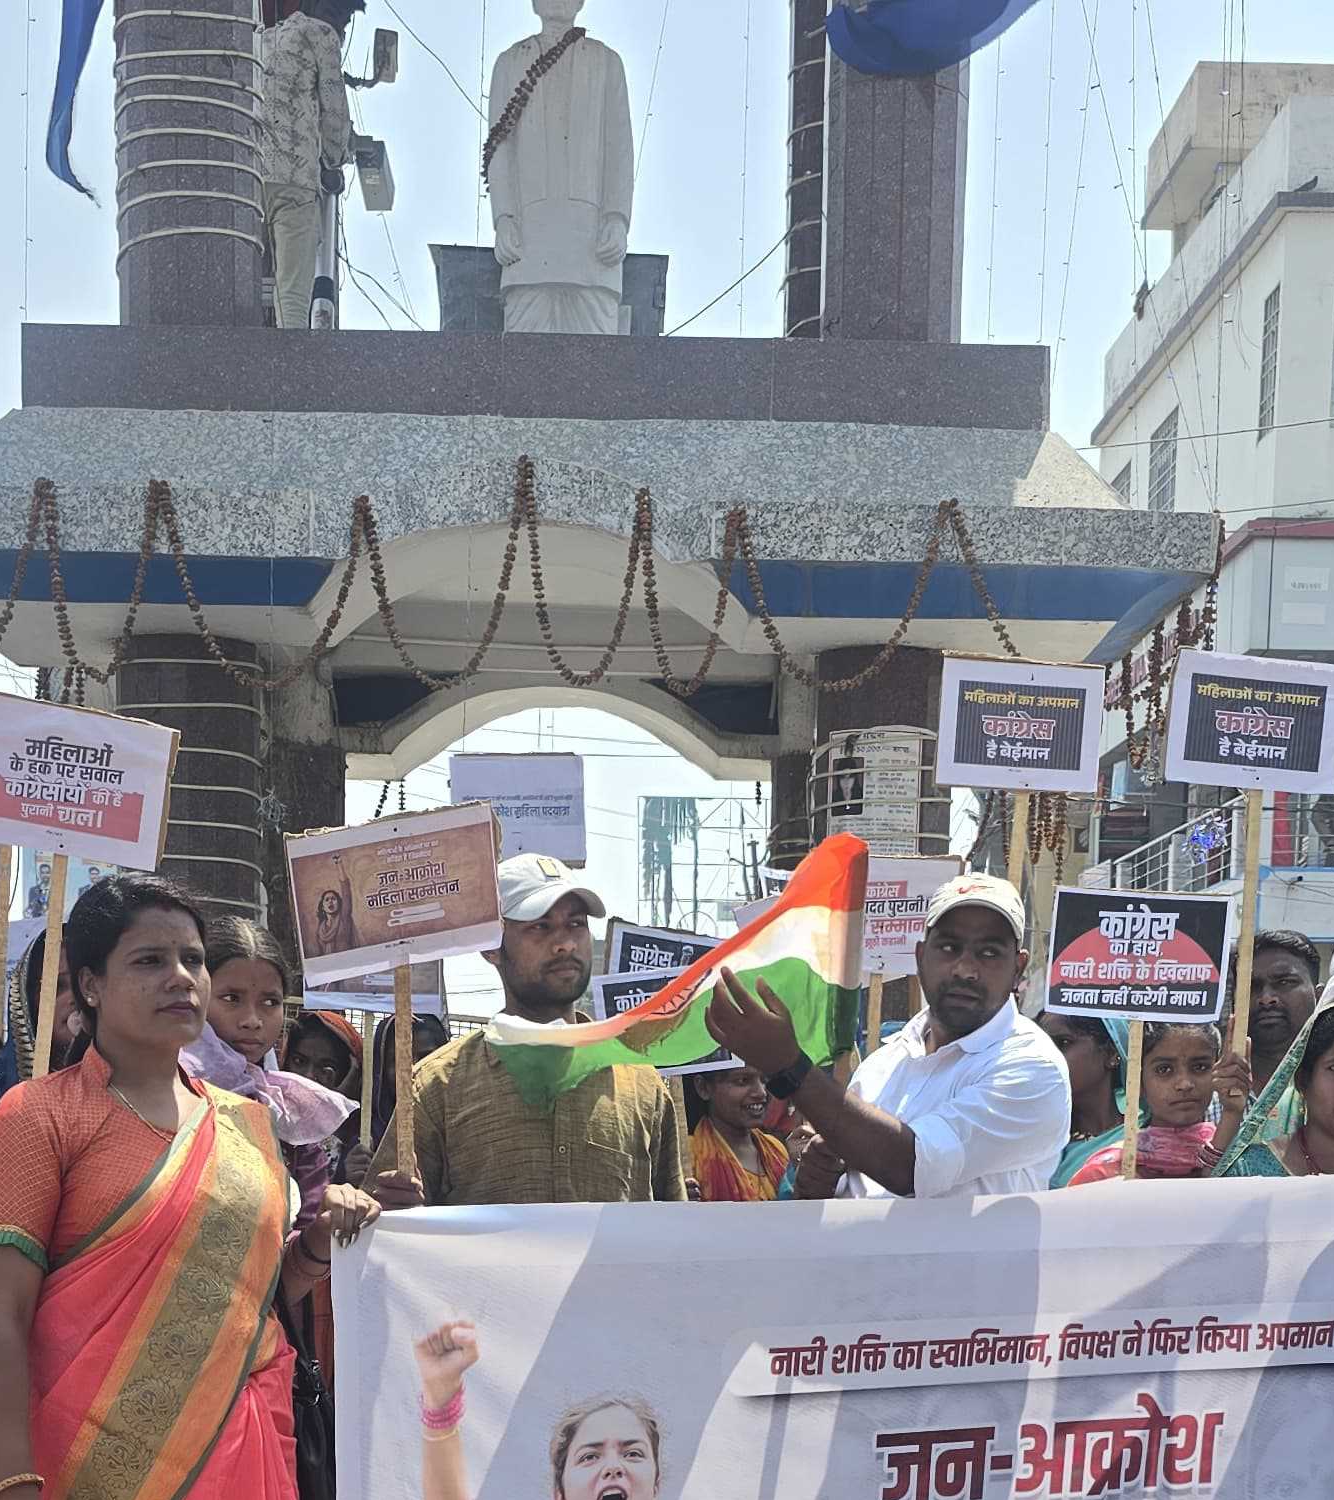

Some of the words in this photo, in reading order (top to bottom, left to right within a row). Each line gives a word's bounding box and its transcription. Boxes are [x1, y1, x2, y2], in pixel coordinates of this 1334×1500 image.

[964, 688, 1017, 705] महिलाओं
[1017, 695, 1036, 707] का
[1036, 696, 1080, 709] अपमान
[1197, 682, 1253, 701] महिलाओं
[1254, 690, 1274, 703] का
[1274, 692, 1321, 707] अपमान
[981, 710, 1056, 740] कांग्रेस
[1215, 706, 1295, 740] कांग्रेस
[24, 735, 115, 768] महिलाओं
[986, 738, 998, 759] है
[999, 740, 1051, 761] बेईमान
[1218, 735, 1232, 757] है
[1233, 738, 1288, 760] बेईमान
[8, 752, 26, 772] के
[26, 758, 52, 776] हक
[55, 763, 75, 779] पर
[78, 765, 126, 786] सवाल
[20, 801, 54, 819] पुरानी
[91, 788, 110, 806] की
[110, 789, 125, 808] है
[377, 860, 446, 887] जन-आक्रोश
[366, 888, 406, 909] महिला
[406, 878, 461, 902] सम्मेलन
[871, 919, 927, 935] सम्मान
[1098, 903, 1180, 941] कांग्रेस
[630, 943, 675, 967] कांग्रेस
[1109, 939, 1131, 956] का
[1060, 957, 1096, 979] नारी
[1098, 958, 1134, 980] शक्ति
[1135, 958, 1153, 981] के
[1154, 959, 1214, 982] खिलाफ
[1060, 988, 1101, 1005] जनता
[1101, 985, 1133, 1006] नहीं
[1130, 986, 1169, 1006] करेगी
[769, 1335, 829, 1377] नारी
[831, 1333, 891, 1375] शक्ति
[891, 1340, 927, 1371] का
[928, 1327, 1051, 1369] स्वाभिमान,
[1058, 1323, 1120, 1361] विपक्ष
[1121, 1319, 1146, 1357] ने
[1147, 1318, 1194, 1356] फिर
[1195, 1315, 1253, 1353] किया
